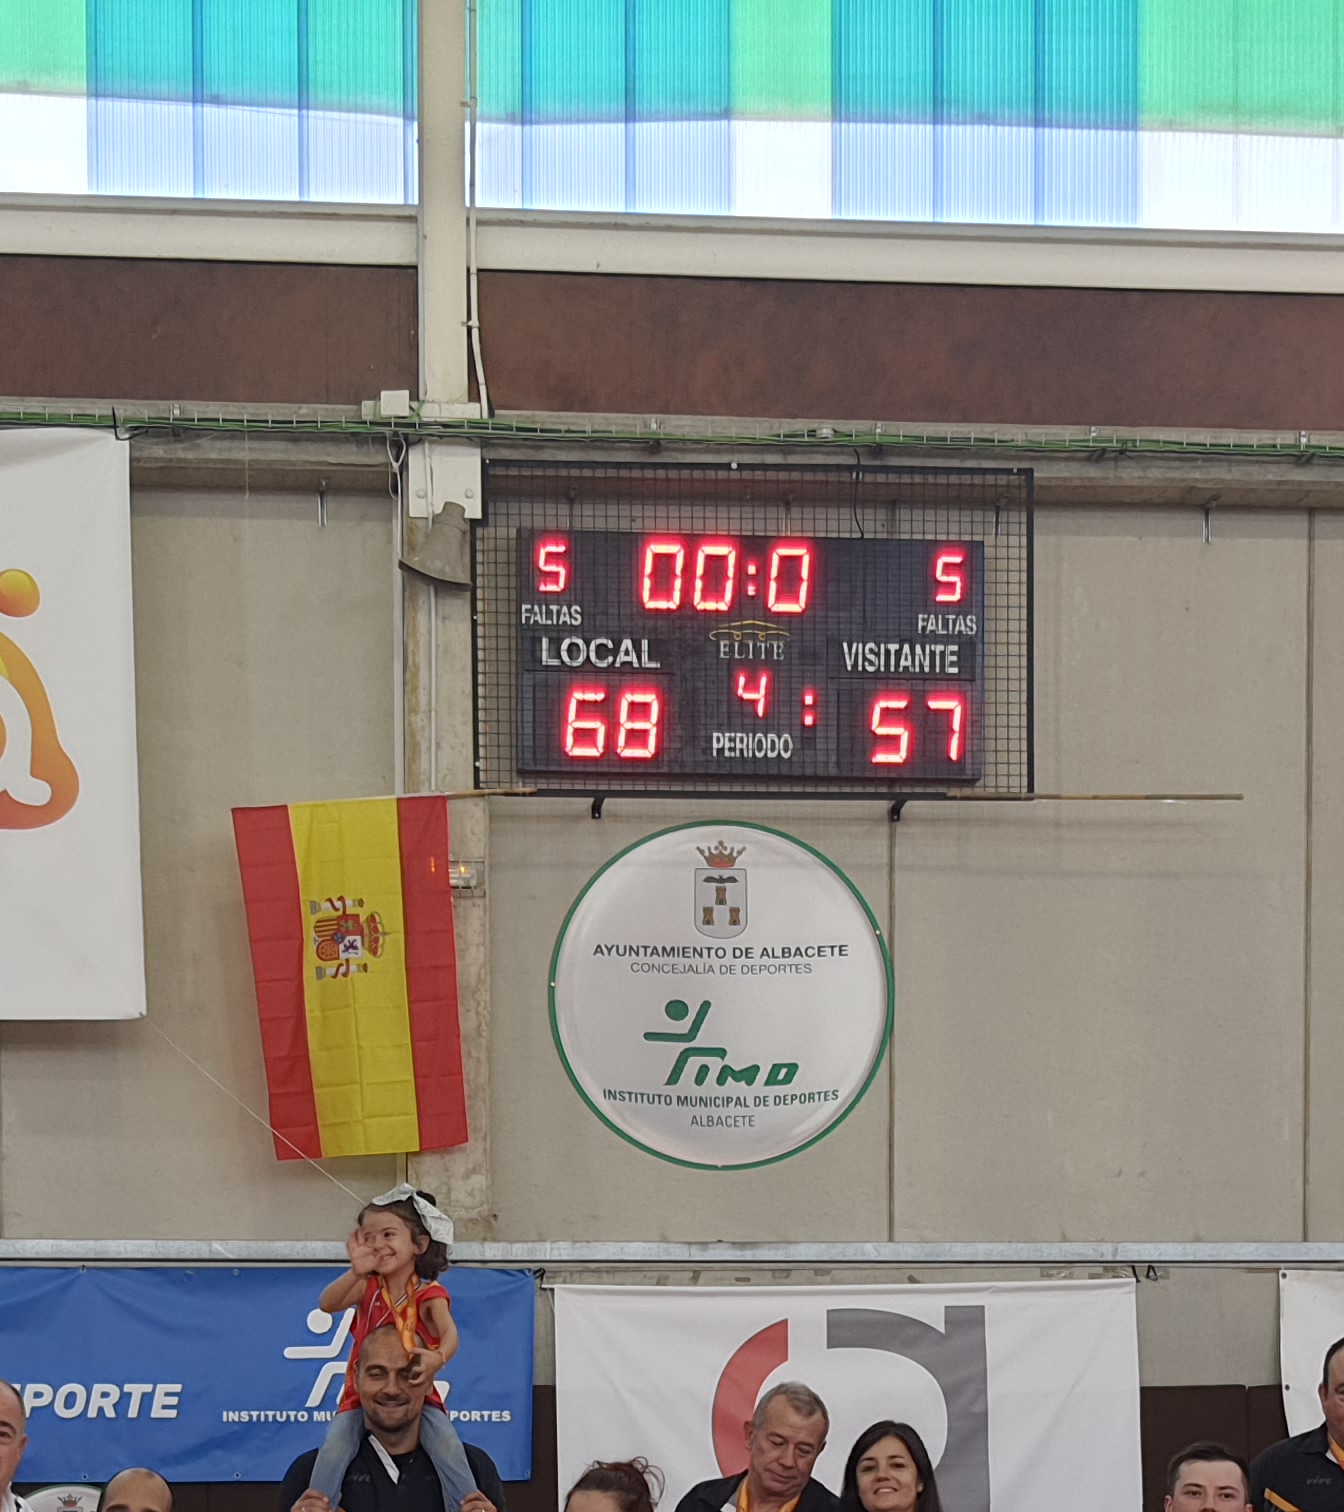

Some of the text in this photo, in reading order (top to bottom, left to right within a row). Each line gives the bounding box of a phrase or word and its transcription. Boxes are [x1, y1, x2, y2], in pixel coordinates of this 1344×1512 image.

[537, 543, 568, 593] 5
[641, 543, 811, 614] 00:0
[934, 554, 965, 603] 5
[521, 604, 582, 626] FALTAS
[917, 614, 977, 636] FALTAS
[541, 638, 661, 669] LOCAL
[719, 640, 786, 661] ELITE
[842, 642, 960, 675] VISITANTE
[737, 673, 767, 718] 4
[564, 691, 659, 759] 68
[870, 699, 963, 764] 57
[712, 731, 793, 759] PERIODO
[593, 944, 849, 960] AYUNTAMIENTO DE ALBACETE
[719, 964, 737, 975] DE
[741, 963, 812, 975] DEPORTES
[603, 1088, 839, 1108] INSTITUTO MUNICIPAL DE DEPORTES
[690, 1115, 755, 1128] ALBACETE
[11, 1383, 183, 1419] PORTE
[222, 1410, 309, 1422] INSTITUTO
[449, 1410, 511, 1422] PORTES
